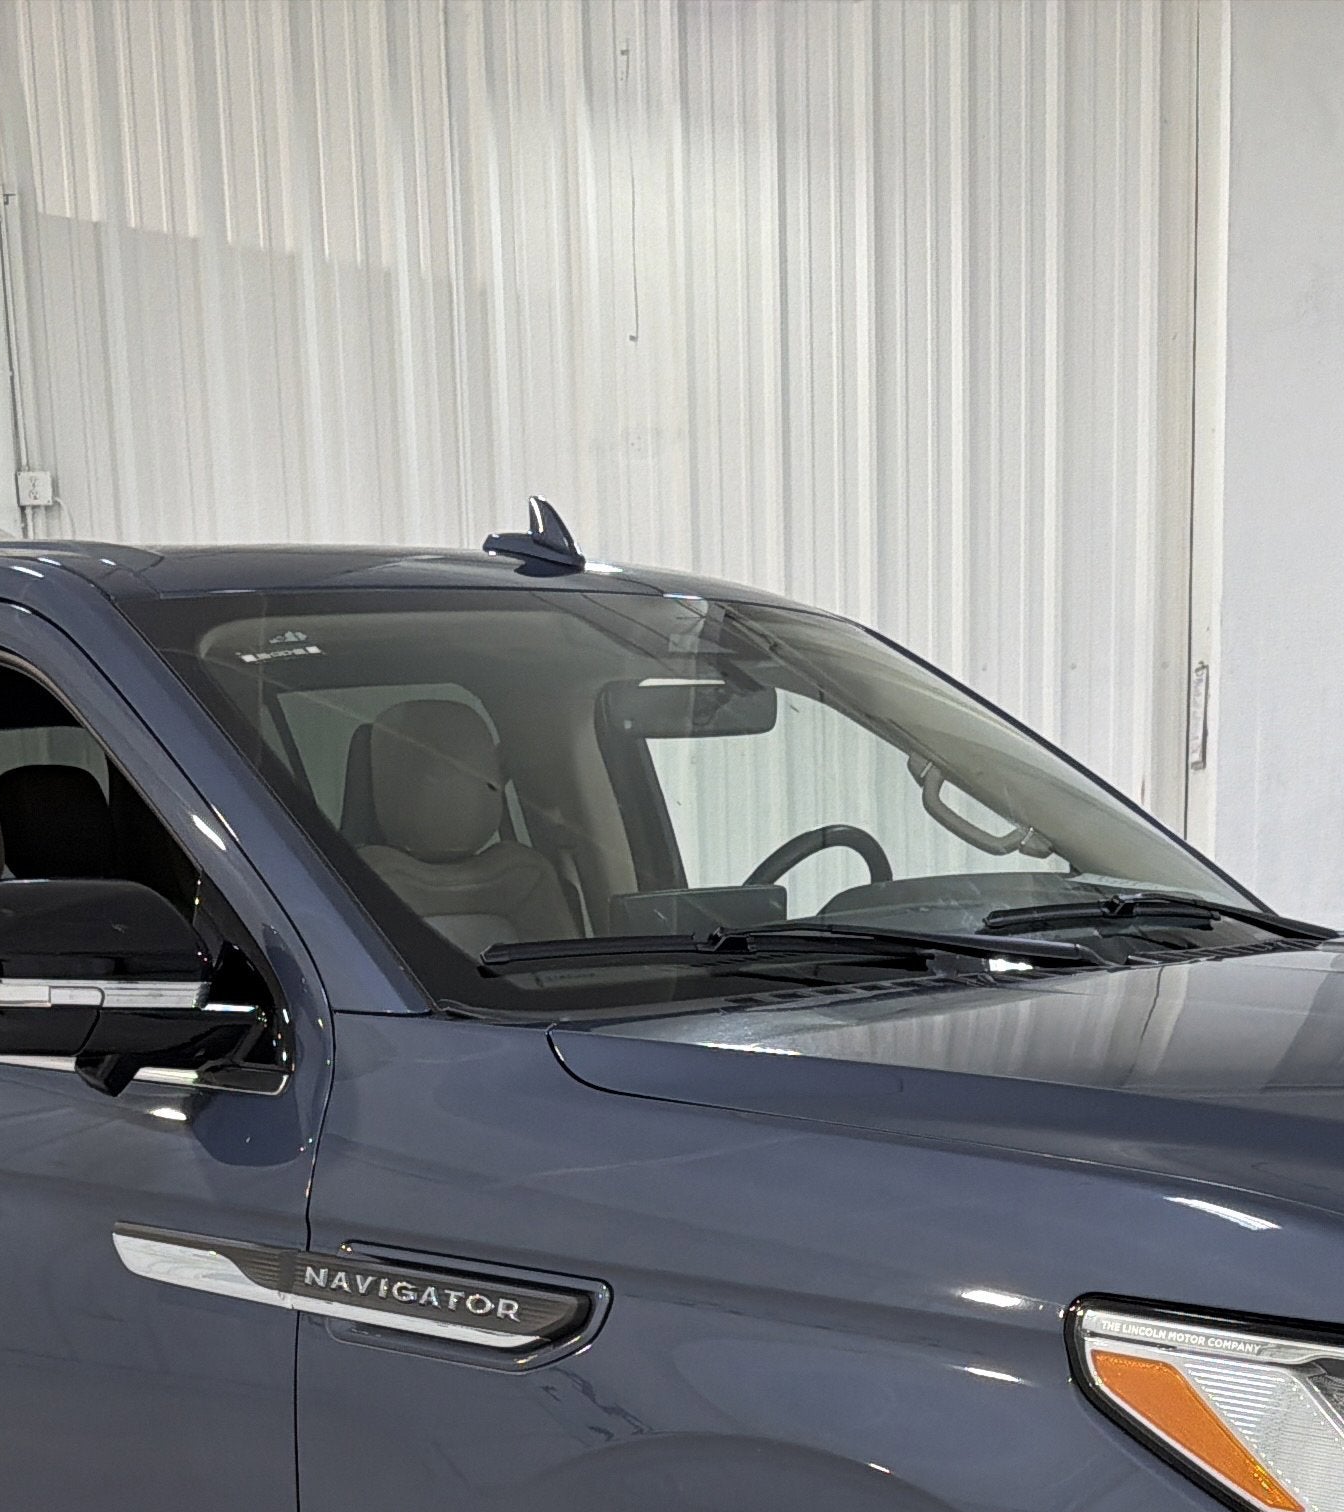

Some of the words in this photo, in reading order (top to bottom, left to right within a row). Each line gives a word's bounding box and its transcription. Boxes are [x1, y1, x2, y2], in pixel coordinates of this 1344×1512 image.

[304, 1265, 521, 1323] NAVIGATOR
[1101, 1320, 1121, 1332] THE
[1122, 1325, 1167, 1340] LINCOLN
[1168, 1331, 1205, 1346] MOTOR
[1207, 1337, 1262, 1353] COMPANY
